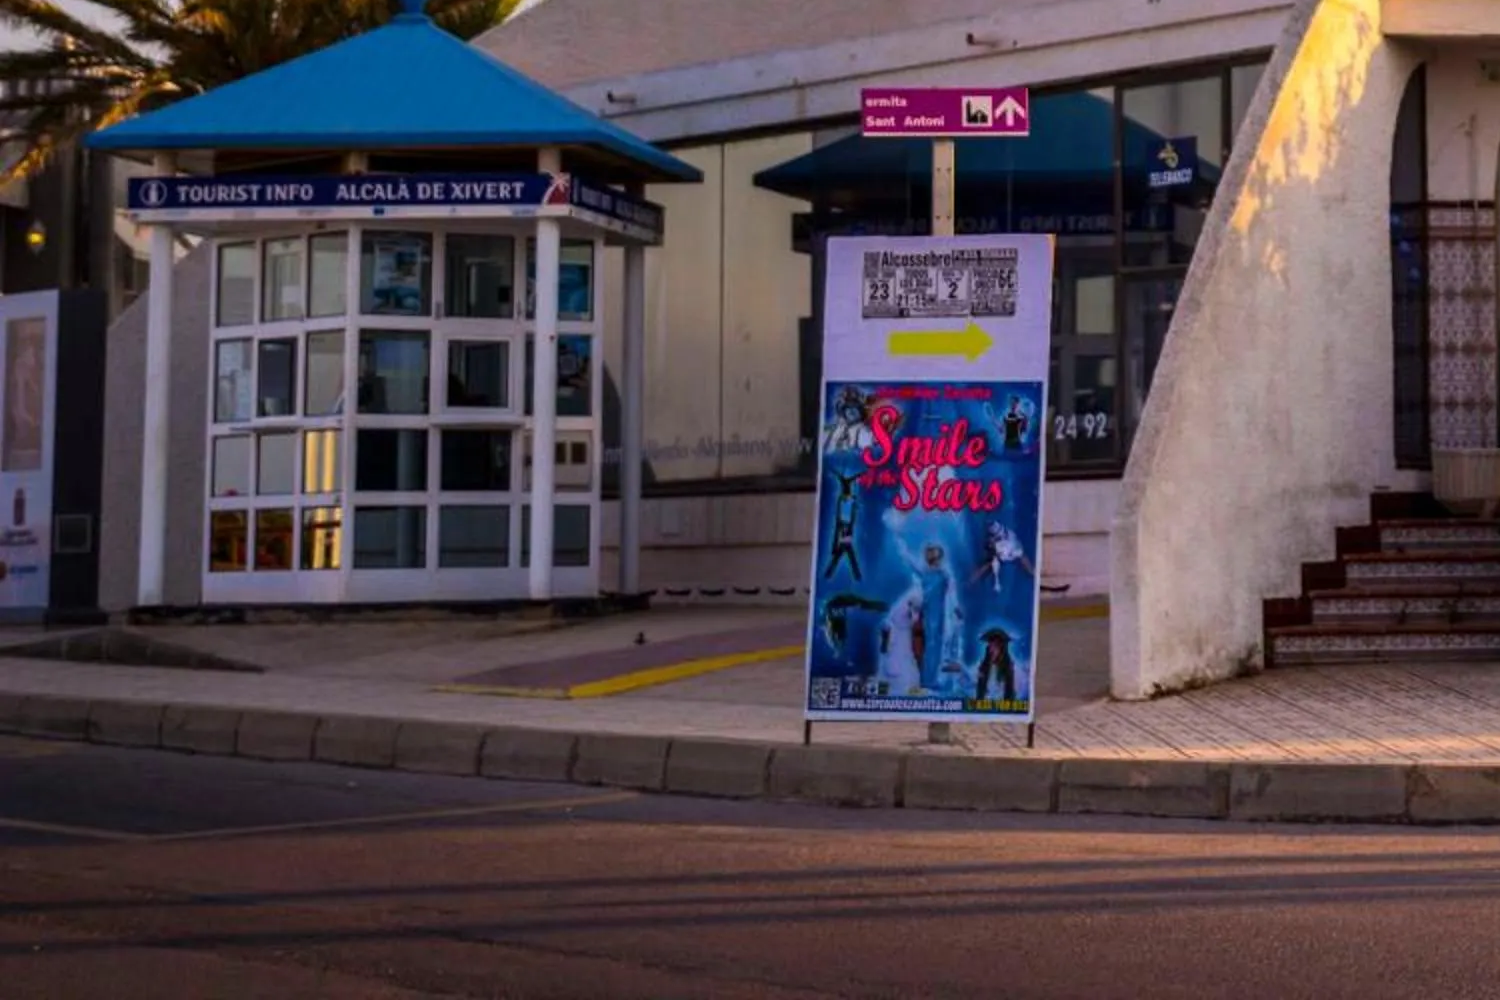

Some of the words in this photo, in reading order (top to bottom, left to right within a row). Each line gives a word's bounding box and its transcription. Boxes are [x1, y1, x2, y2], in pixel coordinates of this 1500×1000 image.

[866, 95, 907, 108] ermita
[866, 115, 895, 127] Sant
[903, 115, 945, 127] Antoni
[177, 184, 261, 202] TOURIST
[266, 184, 313, 200] INFO
[416, 183, 445, 200] DE
[450, 182, 525, 200] XIVERT
[869, 283, 890, 300] 23
[948, 282, 959, 299] 2
[1054, 416, 1078, 440] 24
[1083, 412, 1108, 437] 92
[862, 405, 987, 467] Smile
[893, 464, 1004, 513] Stars
